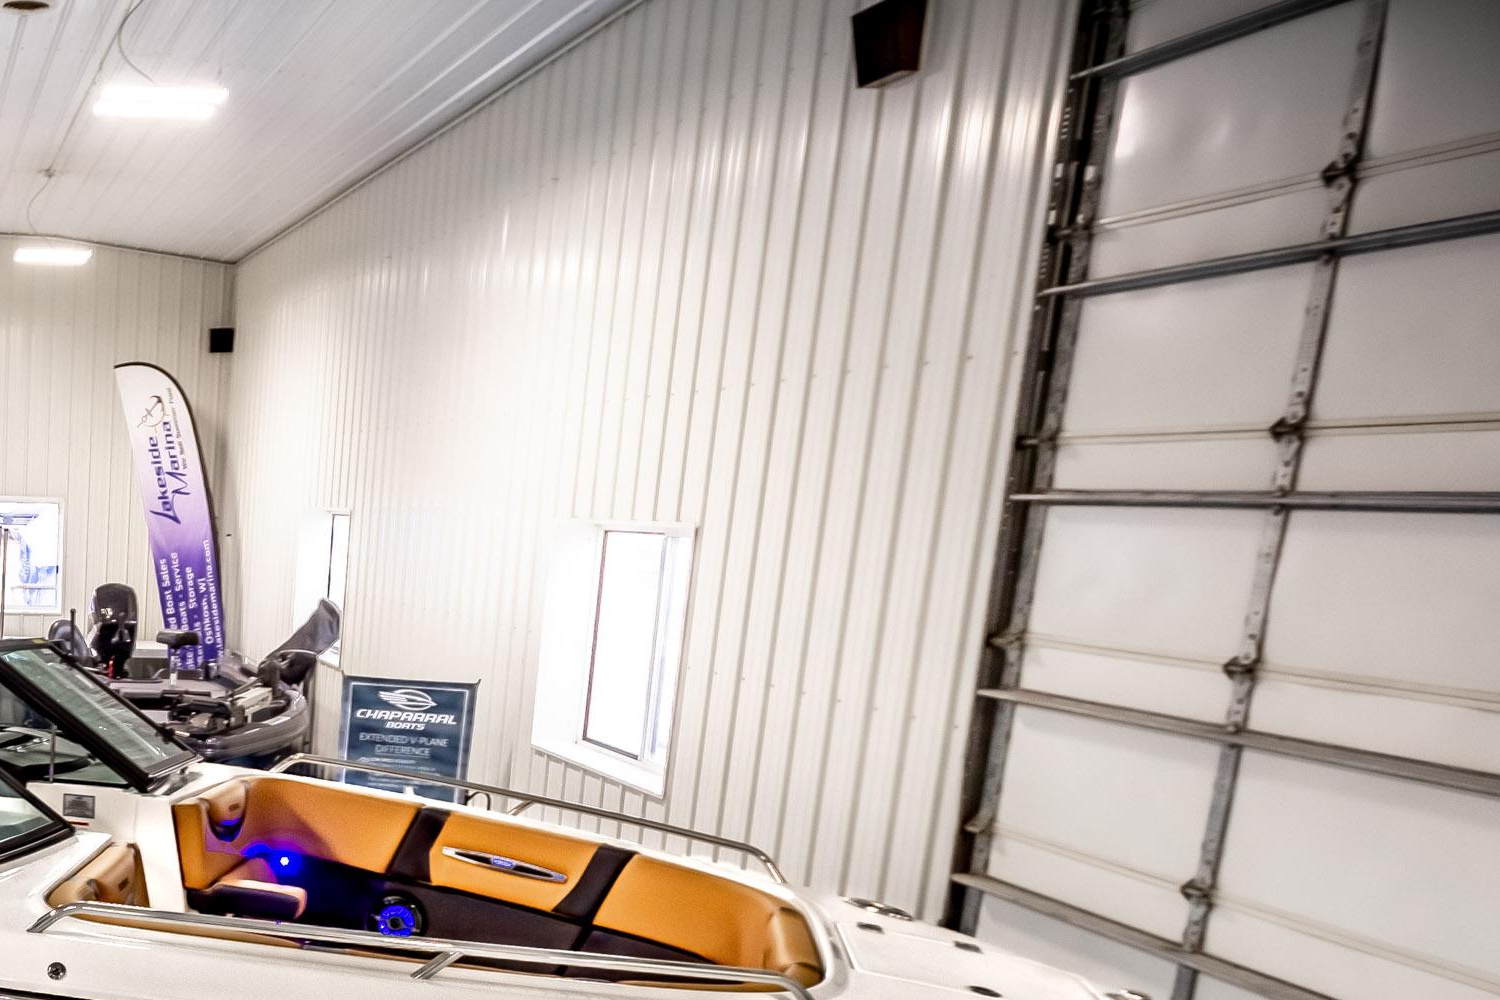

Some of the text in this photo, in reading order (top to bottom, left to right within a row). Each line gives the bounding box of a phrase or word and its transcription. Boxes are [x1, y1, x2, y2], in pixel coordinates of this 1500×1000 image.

[162, 421, 191, 496] Marina
[148, 436, 181, 525] Lakeside
[160, 558, 171, 588] Sales
[197, 578, 207, 593] WI
[171, 551, 189, 631] Boats Service
[185, 566, 198, 609] Storage
[164, 589, 175, 615] Boat
[356, 708, 458, 725] CHAPARRAL
[385, 721, 427, 731] BOATS
[358, 732, 408, 744] EXTENDED
[374, 744, 431, 756] DIFFERENCE
